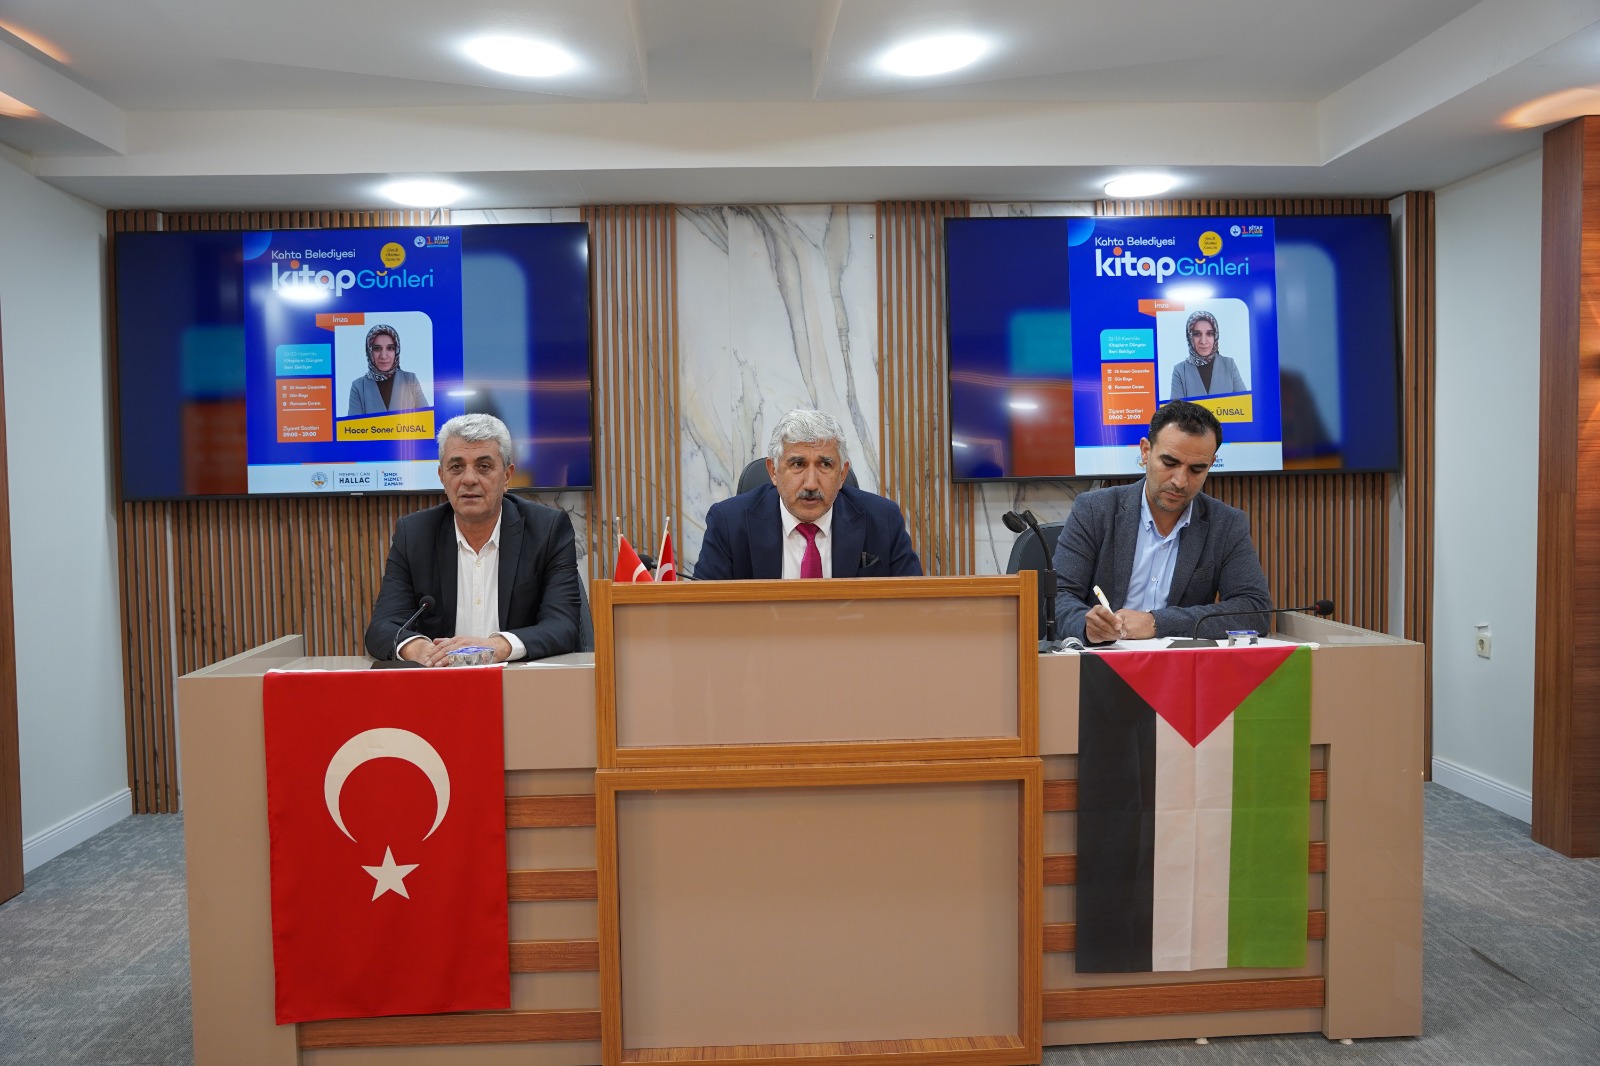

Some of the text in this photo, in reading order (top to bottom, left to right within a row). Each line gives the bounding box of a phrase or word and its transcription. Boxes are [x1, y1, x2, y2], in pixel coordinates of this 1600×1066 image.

[1095, 237, 1175, 248] Kahta Belediyesi
[272, 250, 356, 260] Kahta Belediyesi
[1096, 247, 1176, 283] kitap
[272, 260, 356, 296] kitap
[1216, 407, 1245, 416] ÜNSAL
[370, 426, 394, 434] Soner
[396, 423, 426, 433] ÜNSAL
